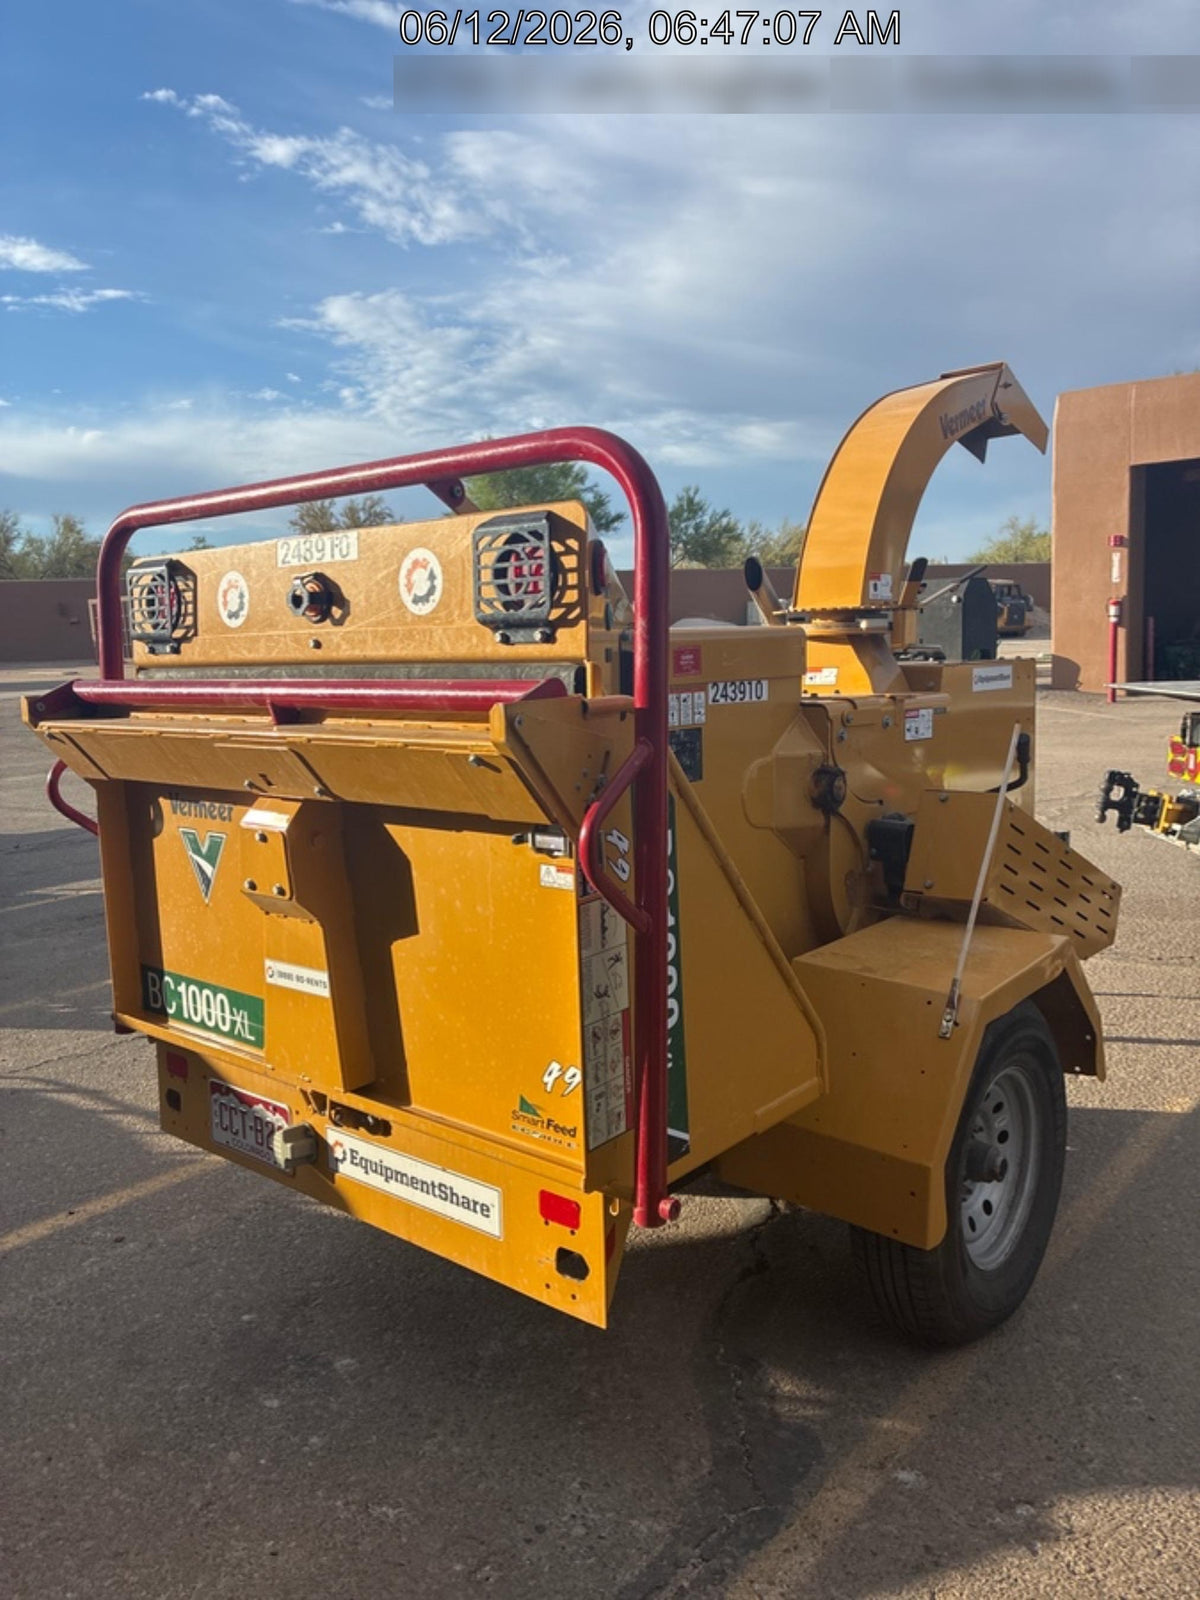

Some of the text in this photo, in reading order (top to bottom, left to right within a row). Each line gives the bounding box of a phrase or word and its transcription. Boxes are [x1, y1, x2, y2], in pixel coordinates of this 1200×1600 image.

[939, 398, 986, 440] Vermeer
[711, 681, 764, 703] 243910
[168, 792, 233, 822] Vermeer
[348, 1148, 491, 1219] EquipmentShare
